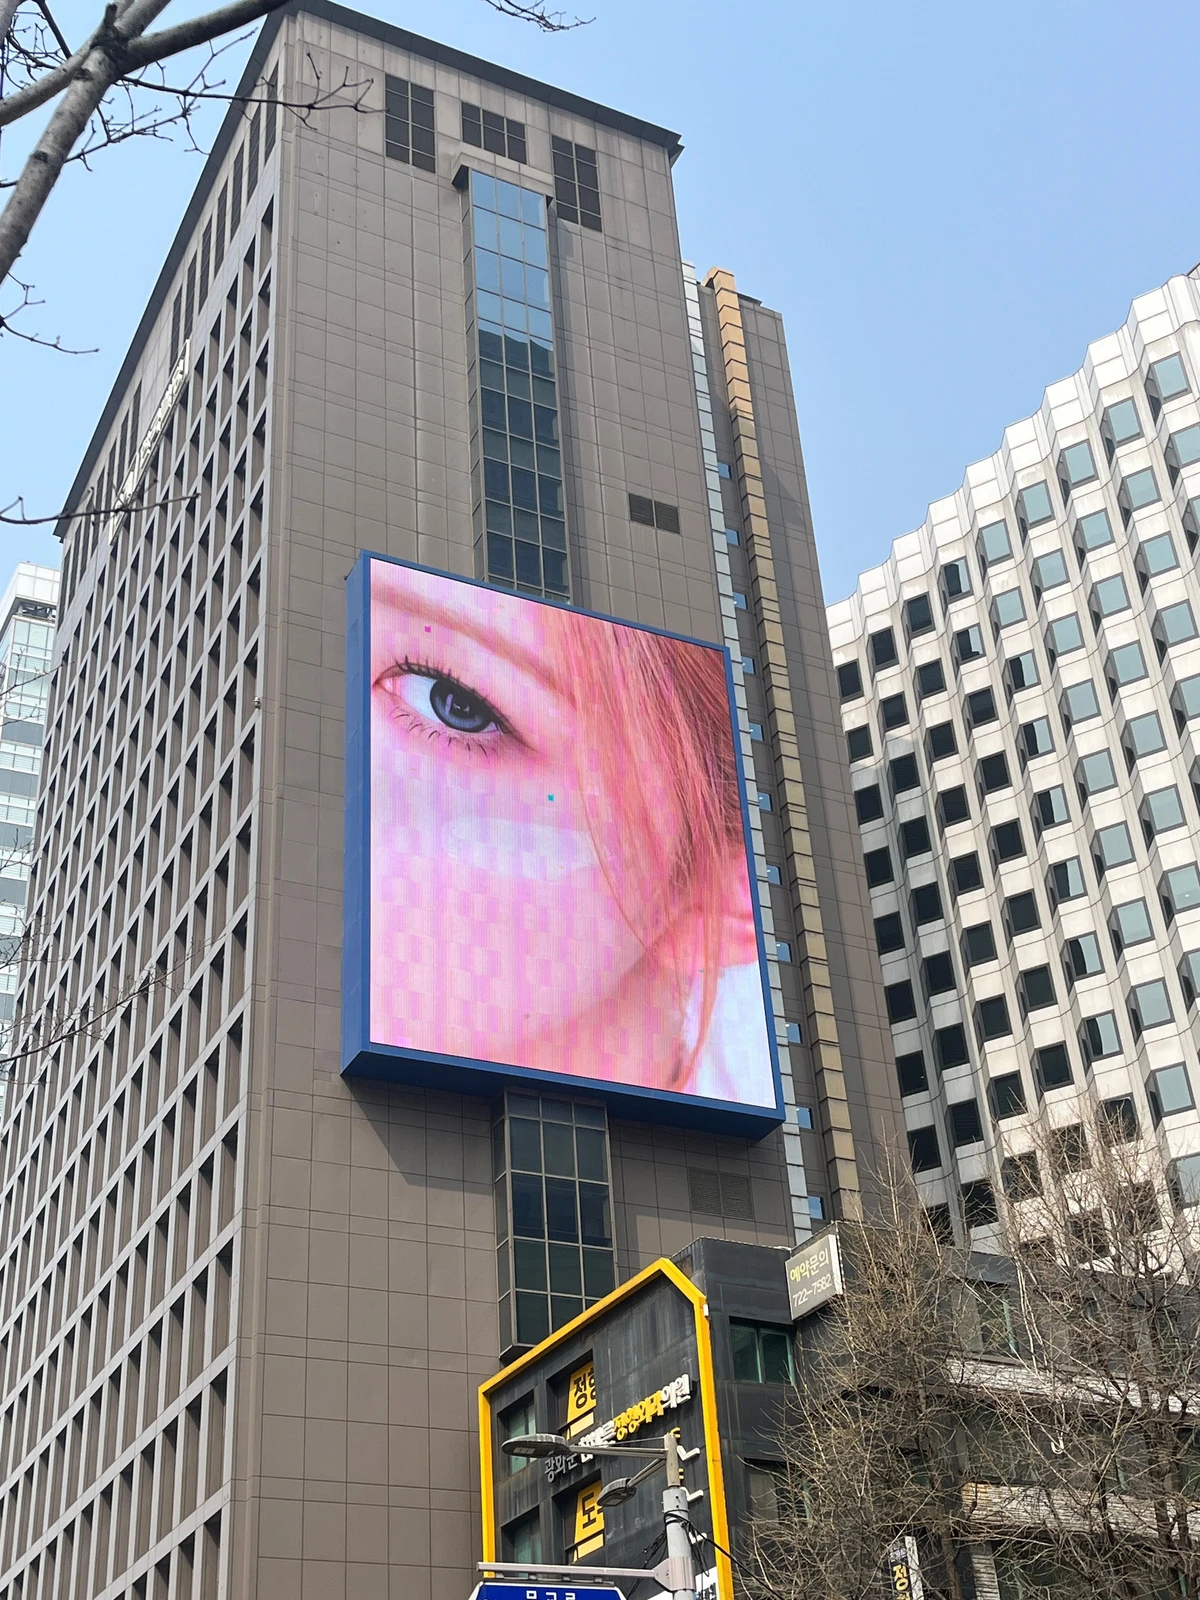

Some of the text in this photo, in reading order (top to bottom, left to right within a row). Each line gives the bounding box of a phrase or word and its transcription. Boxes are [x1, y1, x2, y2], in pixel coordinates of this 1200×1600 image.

[790, 1247, 830, 1282] 예약문의
[792, 1273, 832, 1307] 722-7582
[581, 1491, 604, 1529] 도
